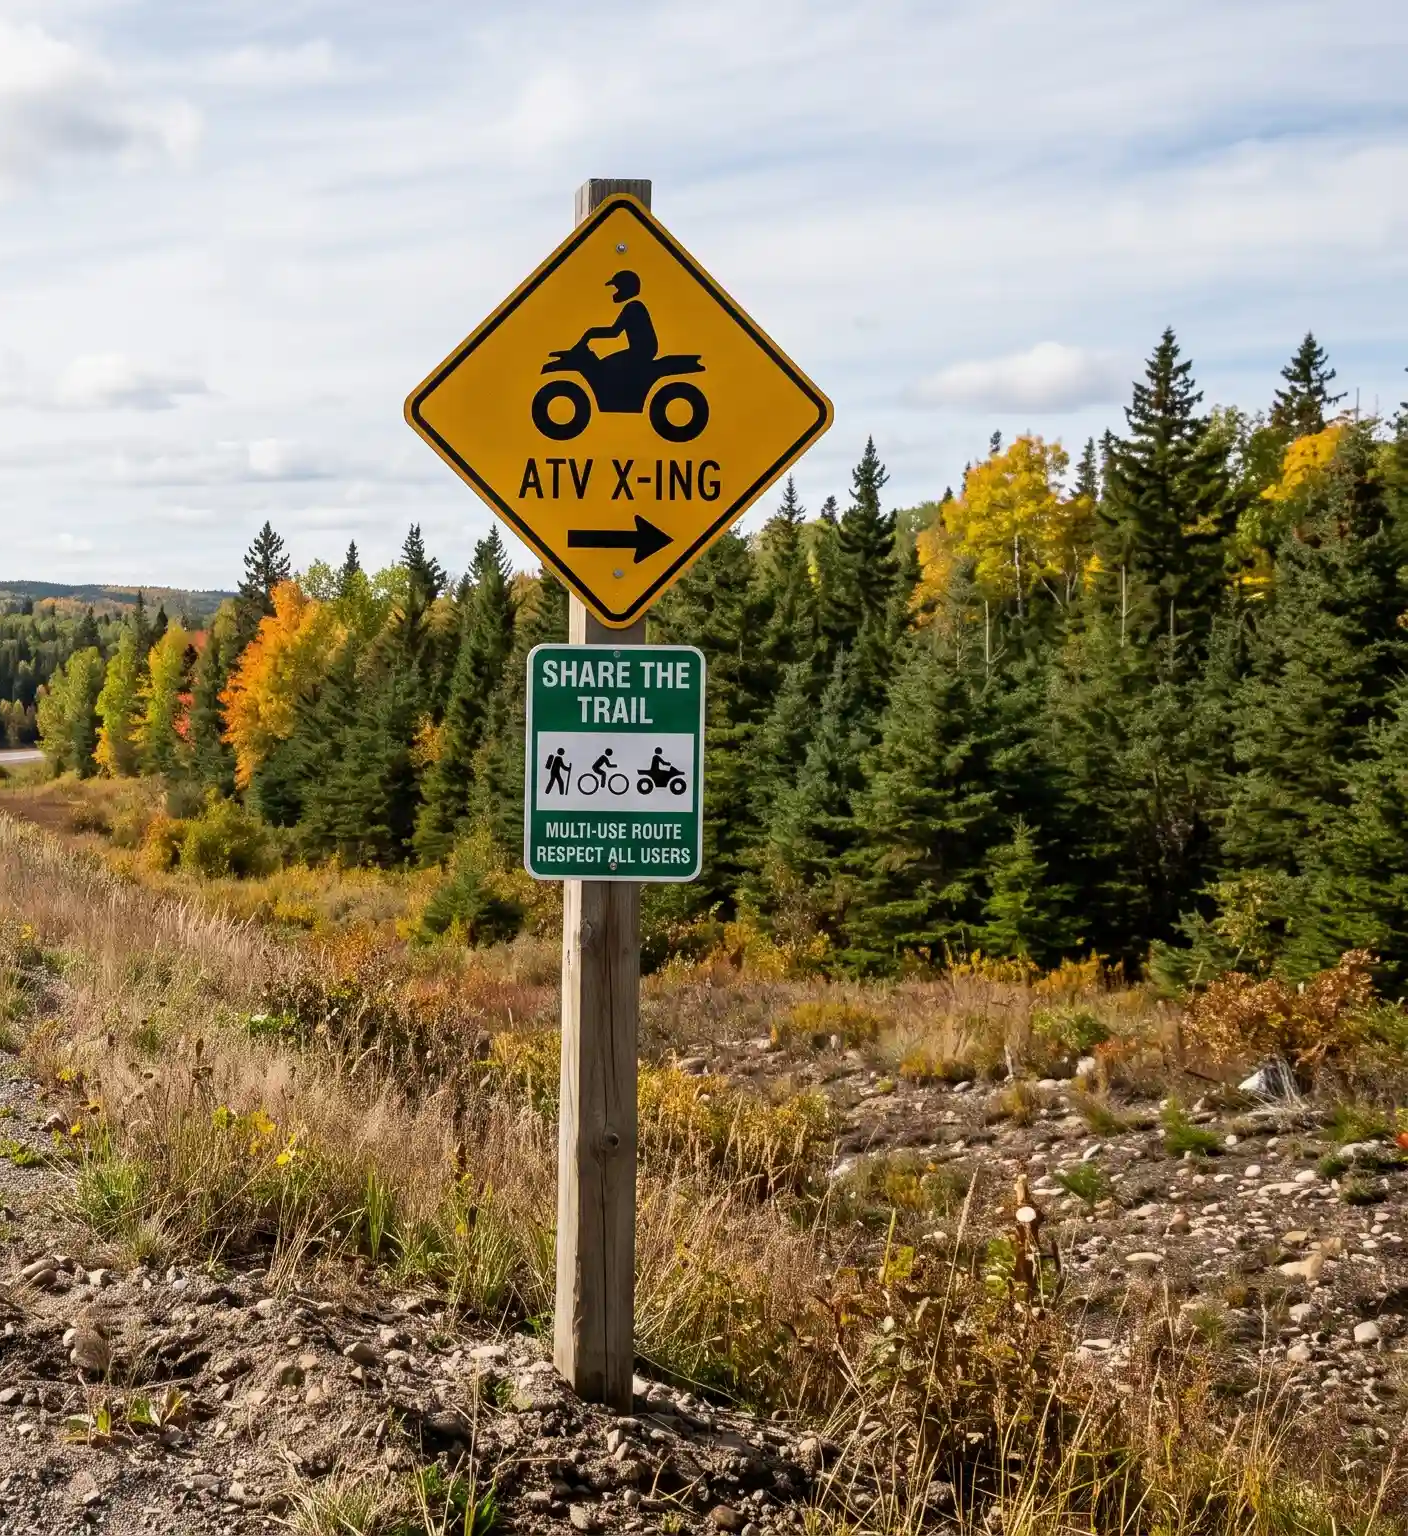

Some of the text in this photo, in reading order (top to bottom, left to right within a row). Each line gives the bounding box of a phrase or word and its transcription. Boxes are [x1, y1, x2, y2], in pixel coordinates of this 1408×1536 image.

[518, 458, 721, 502] ATV X-ING
[542, 660, 690, 689] SHARE THE
[577, 696, 653, 724] TRAIL
[546, 822, 682, 840] MULTI-USE ROUTE
[537, 846, 691, 865] RESPECT ALL USERS
